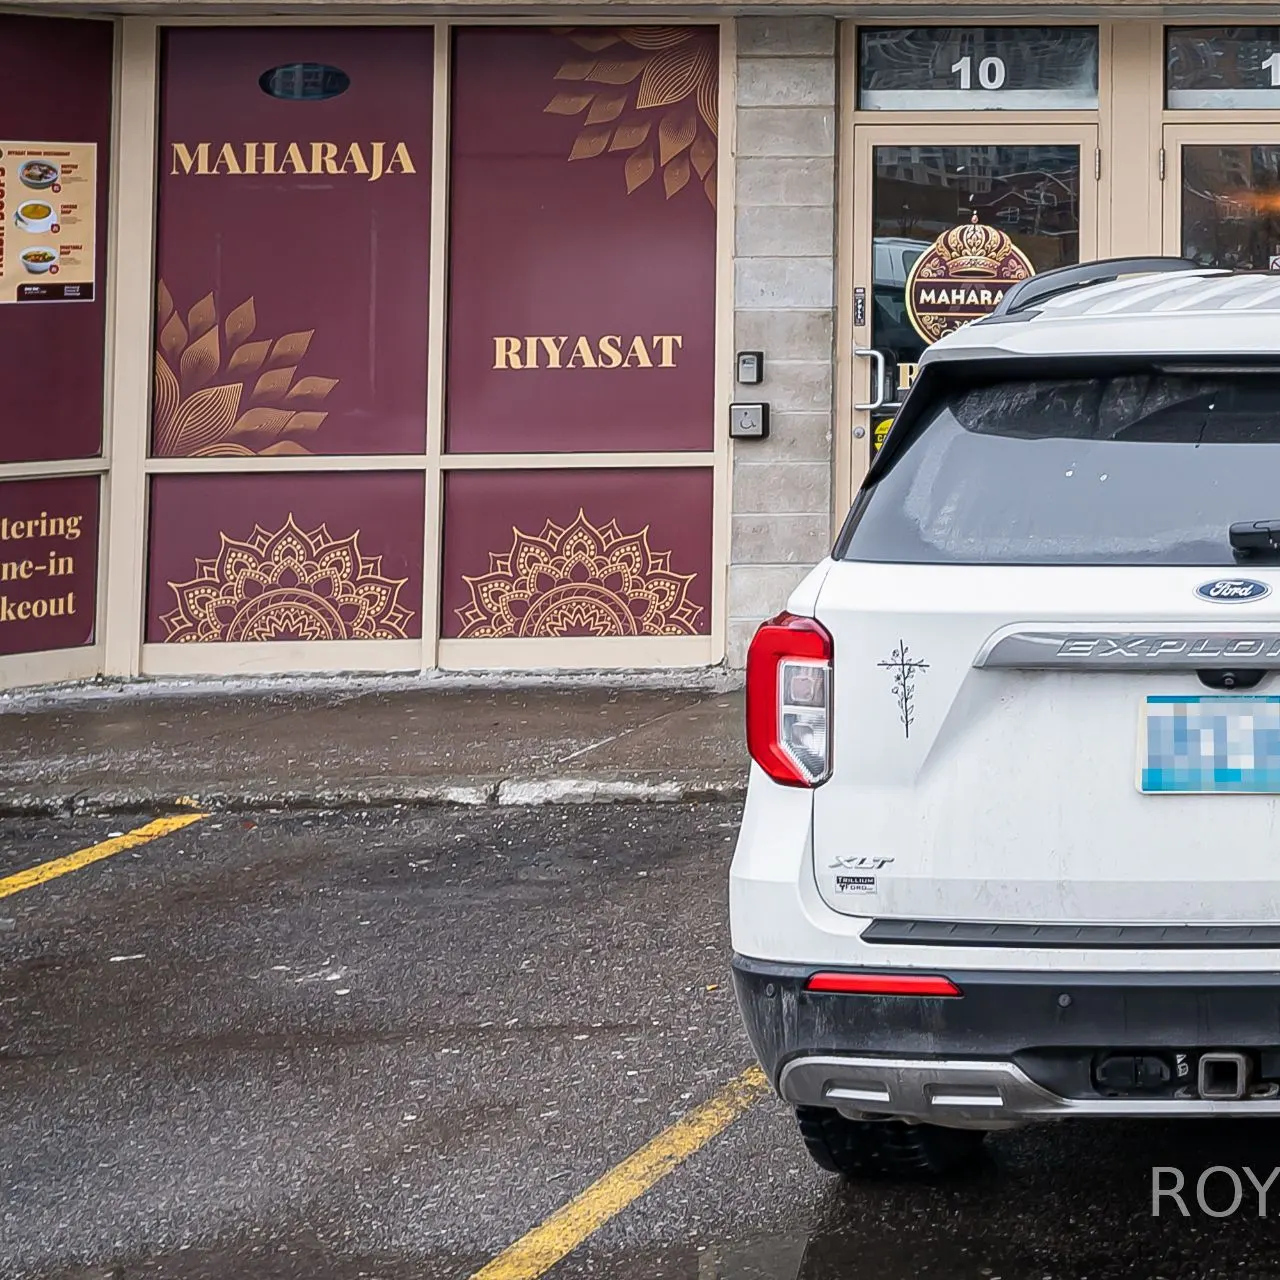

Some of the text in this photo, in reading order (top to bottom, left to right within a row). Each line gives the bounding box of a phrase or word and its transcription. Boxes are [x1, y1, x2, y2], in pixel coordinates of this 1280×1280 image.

[950, 56, 1006, 90] 10
[169, 140, 417, 181] MAHARAJA
[492, 334, 683, 370] RIYASAT
[0, 511, 83, 541] tering
[0, 553, 75, 579] ne-in
[1209, 580, 1254, 598] Ford
[0, 592, 77, 620] keout
[828, 855, 896, 870] XLT
[837, 876, 875, 884] TRILLIUM
